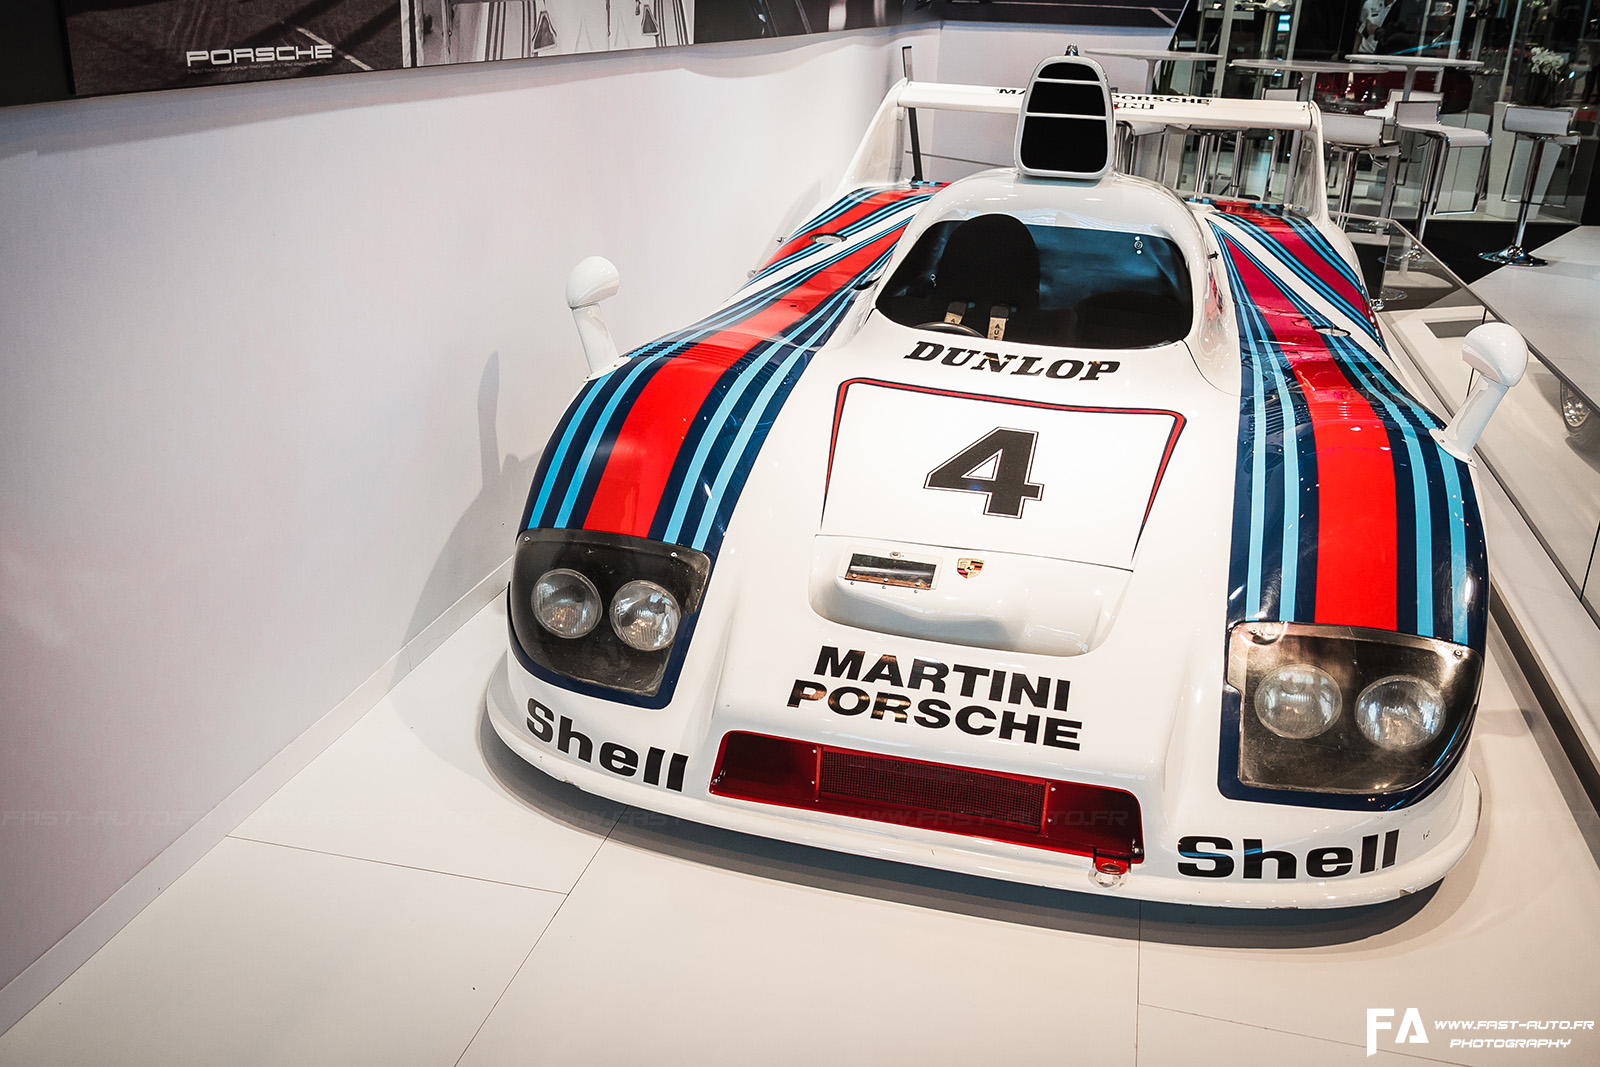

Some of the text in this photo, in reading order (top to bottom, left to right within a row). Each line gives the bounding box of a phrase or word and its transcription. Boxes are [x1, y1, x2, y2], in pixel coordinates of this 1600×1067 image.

[186, 44, 333, 67] PORSCHE
[903, 340, 1121, 381] DUNLOP
[922, 426, 1045, 520] 4
[813, 645, 1071, 712] MARTINI
[526, 697, 690, 793] Shell
[786, 679, 1083, 752] PORSCHE
[1177, 828, 1400, 880] Shell
